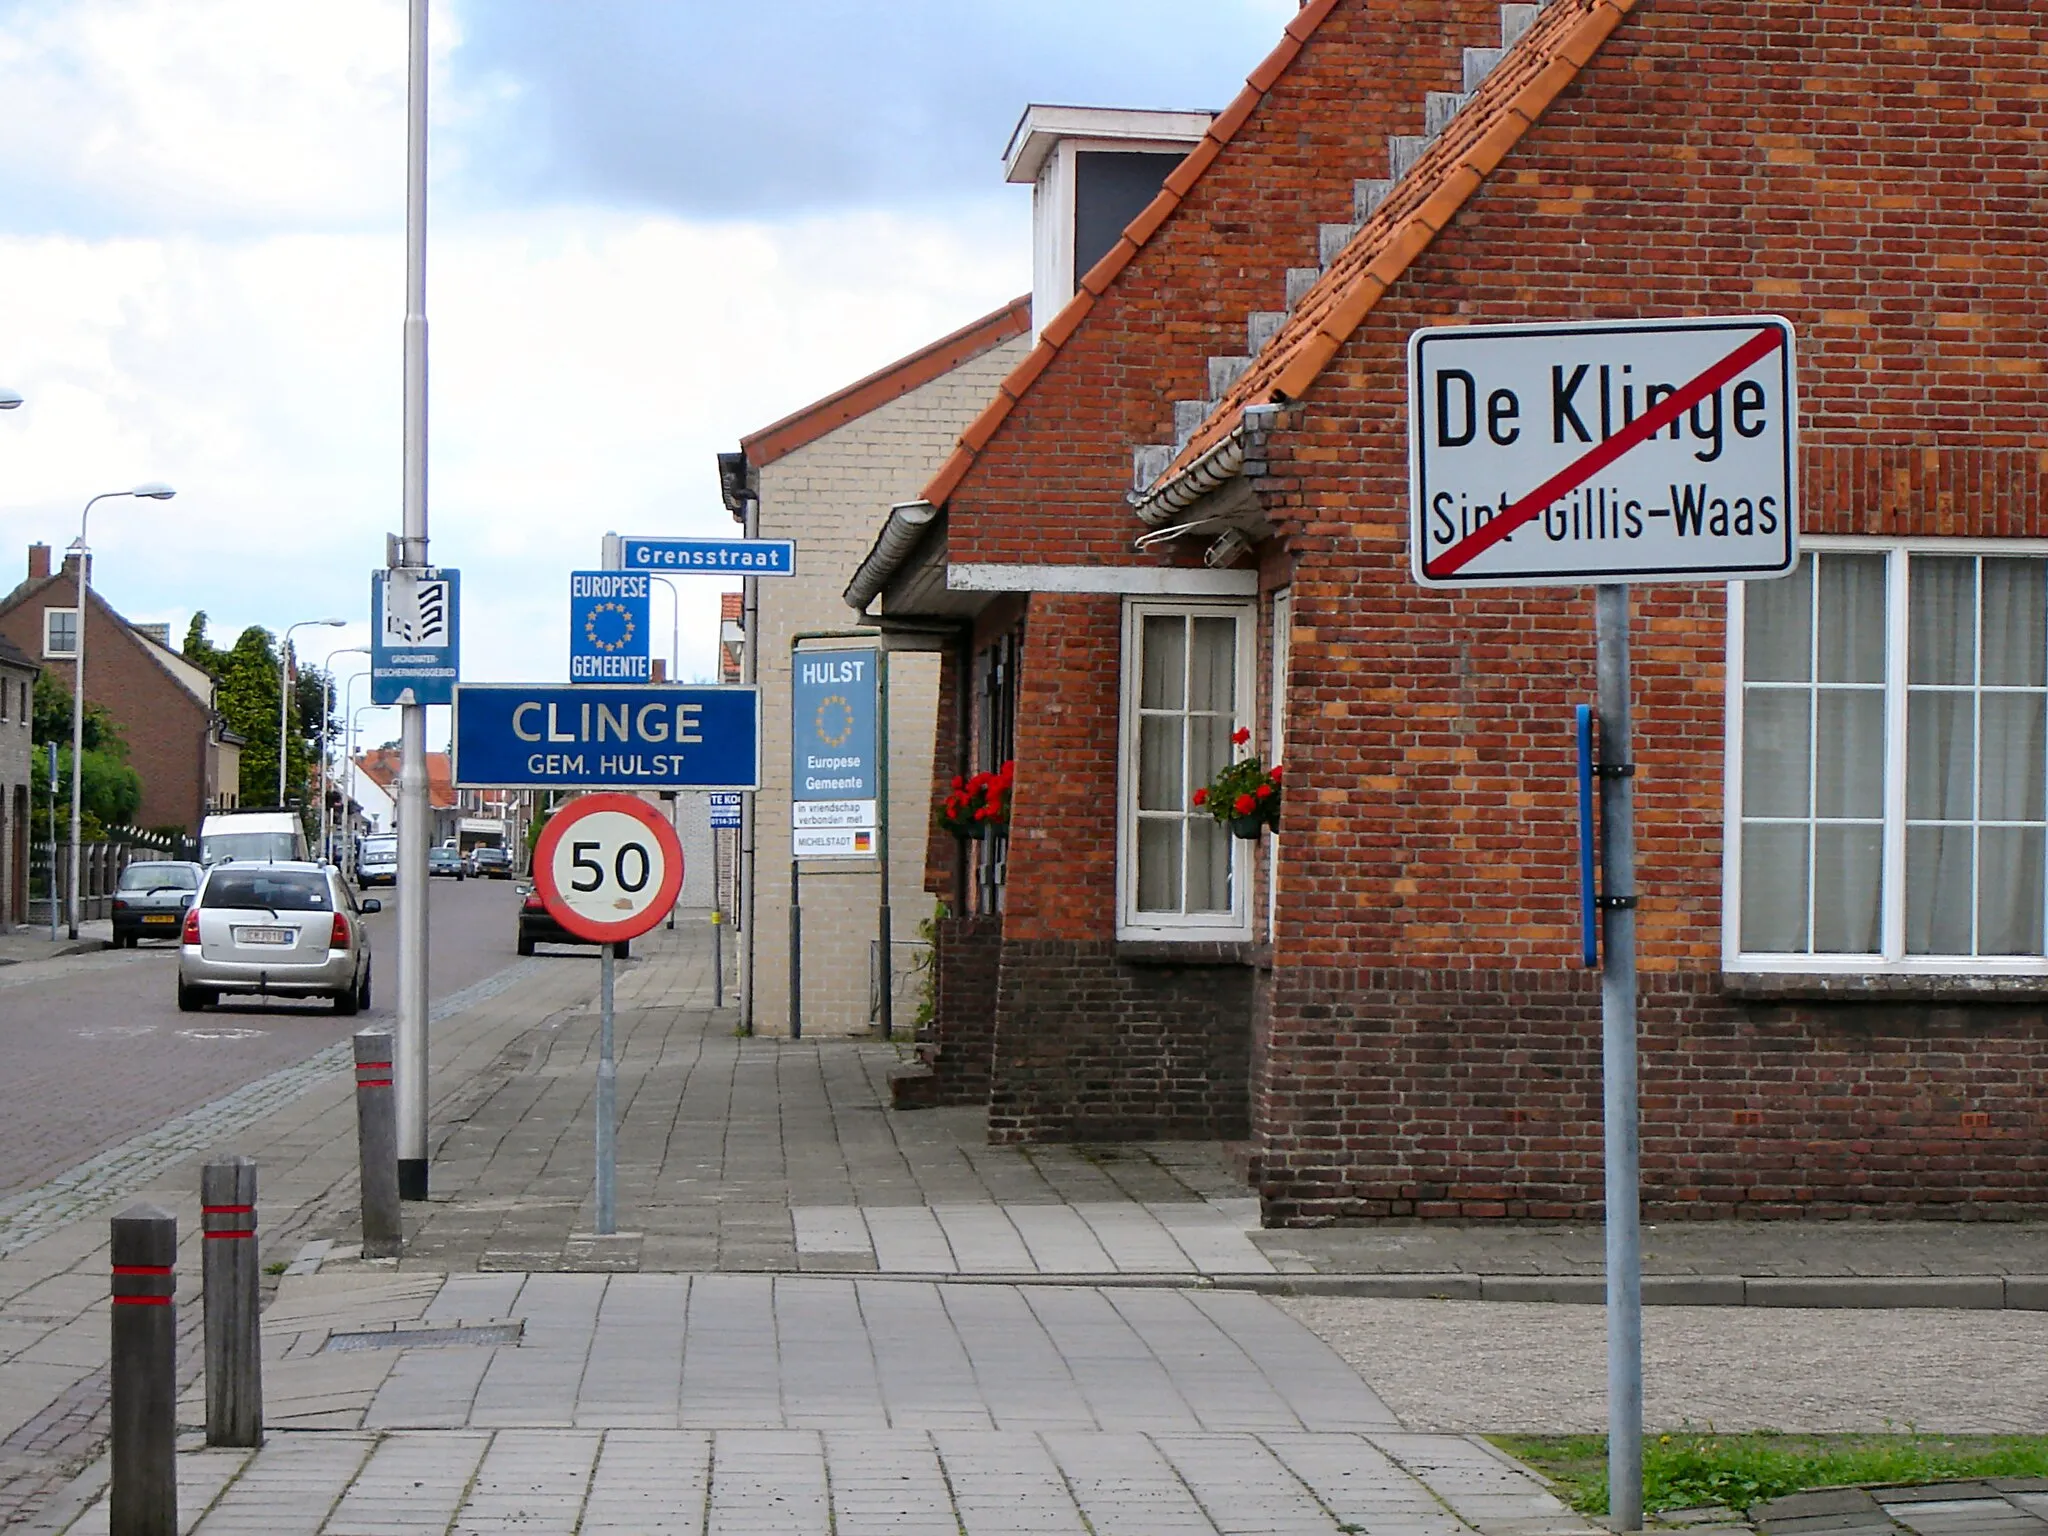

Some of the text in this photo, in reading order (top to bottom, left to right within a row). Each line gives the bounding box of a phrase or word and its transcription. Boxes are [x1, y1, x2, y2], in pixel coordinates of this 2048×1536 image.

[1436, 363, 1766, 462] De Klinge
[636, 546, 780, 566] Grensstraat
[573, 576, 647, 597] EUROPESE
[572, 655, 647, 677] GEMEENTE
[803, 661, 865, 684] HULST
[512, 702, 703, 743] CLINGE
[527, 754, 685, 775] GEM. HULST
[807, 755, 861, 770] Europese
[805, 776, 863, 790] Gemeente
[711, 795, 723, 804] TE
[809, 802, 861, 814] vriendschap
[798, 815, 863, 825] verbonden met
[798, 836, 851, 847] MICHELSTADT
[571, 842, 650, 892] 50
